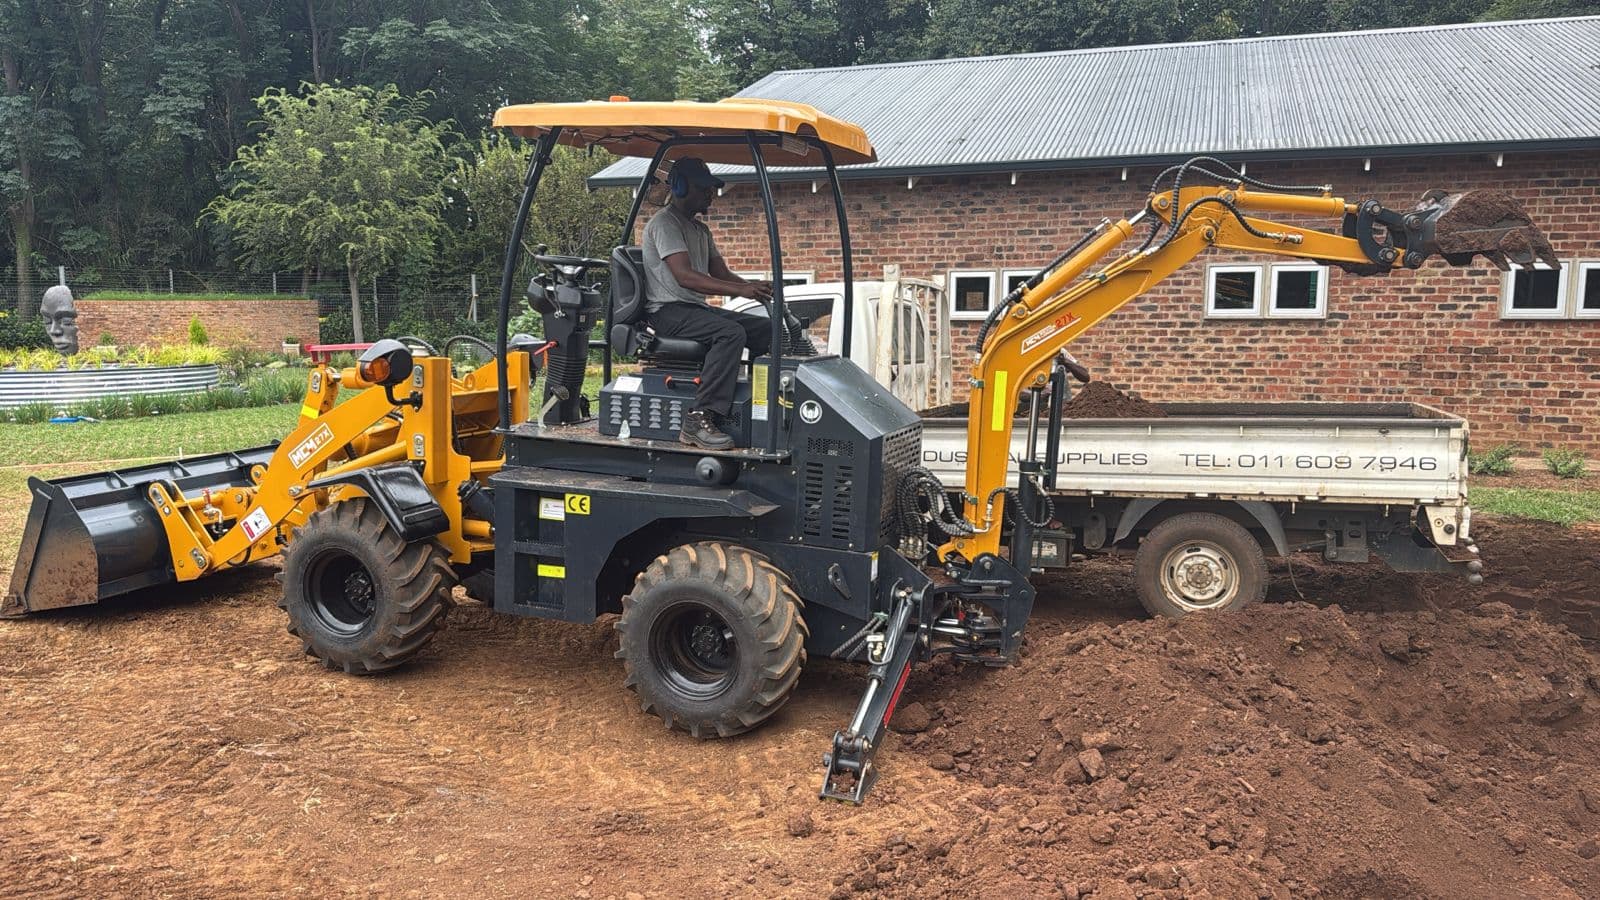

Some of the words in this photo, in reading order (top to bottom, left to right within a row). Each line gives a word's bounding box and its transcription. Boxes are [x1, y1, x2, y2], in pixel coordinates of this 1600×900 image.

[1055, 312, 1075, 329] 27X
[291, 438, 318, 466] MCM
[1179, 453, 1231, 468] TEL:
[1238, 454, 1283, 469] 011
[1296, 455, 1352, 470] 609
[1359, 456, 1437, 471] 7946
[568, 495, 587, 513] CE
